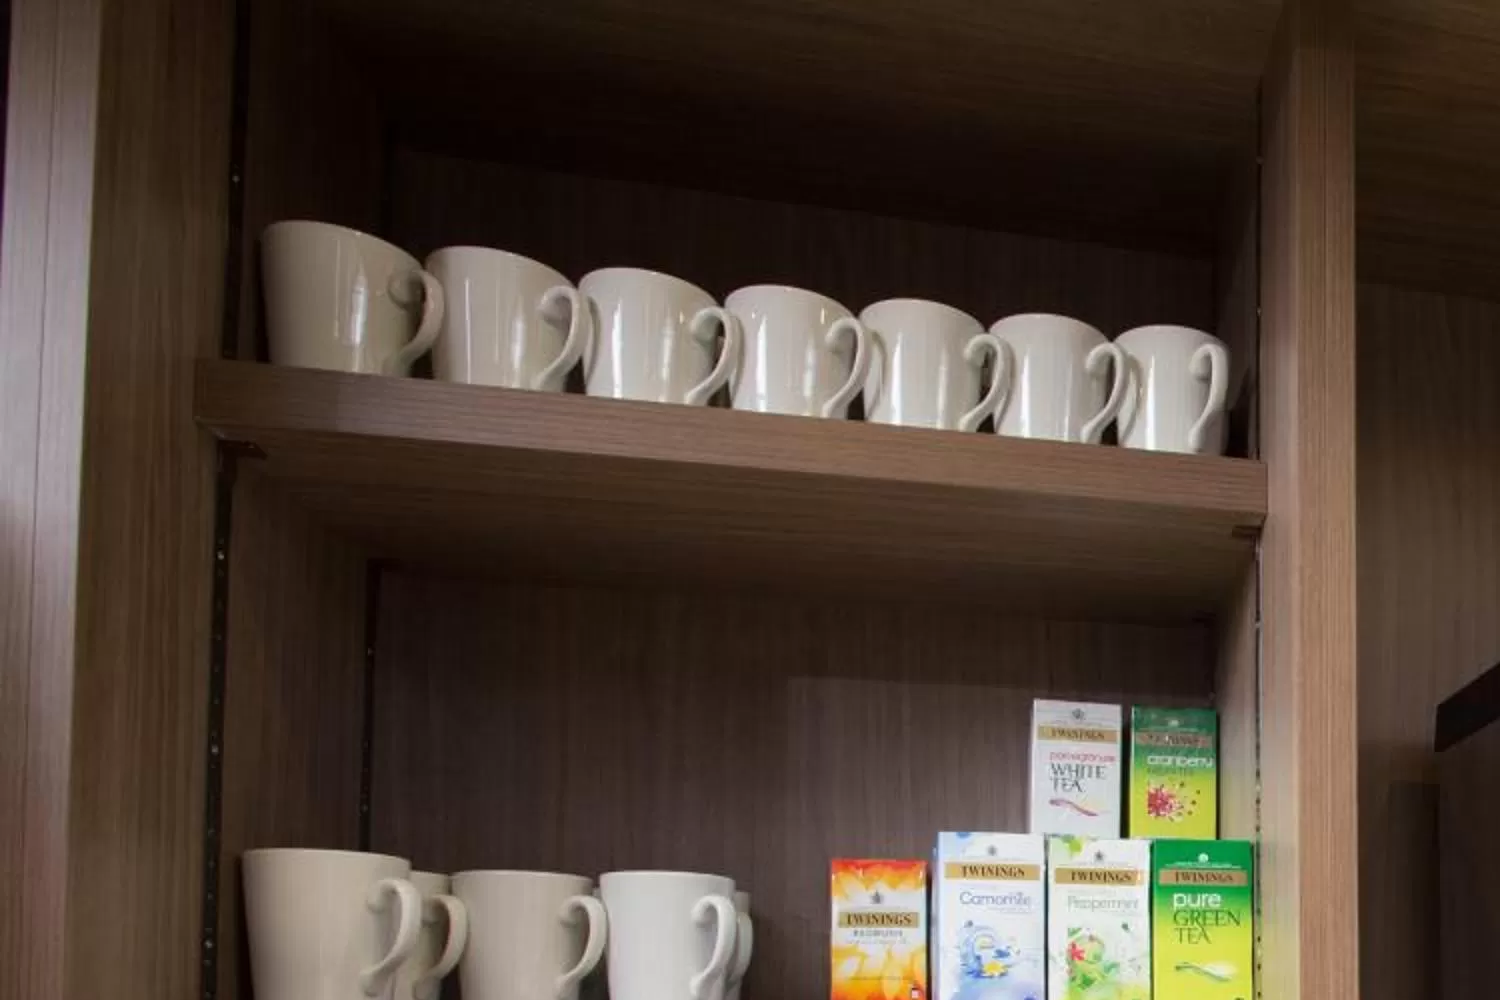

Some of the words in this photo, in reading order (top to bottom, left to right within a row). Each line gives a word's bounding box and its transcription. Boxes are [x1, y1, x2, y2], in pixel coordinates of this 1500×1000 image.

[1050, 763, 1107, 779] WHITE
[1050, 778, 1084, 792] TEA
[960, 864, 1025, 878] TWININGS
[1070, 870, 1132, 883] TWININGS
[1174, 870, 1234, 883] TWININGS
[959, 891, 1031, 906] Camomile
[1173, 892, 1222, 909] pure
[847, 913, 912, 926] TWININGS
[1173, 909, 1241, 926] GREEN
[1174, 927, 1212, 944] TEA
